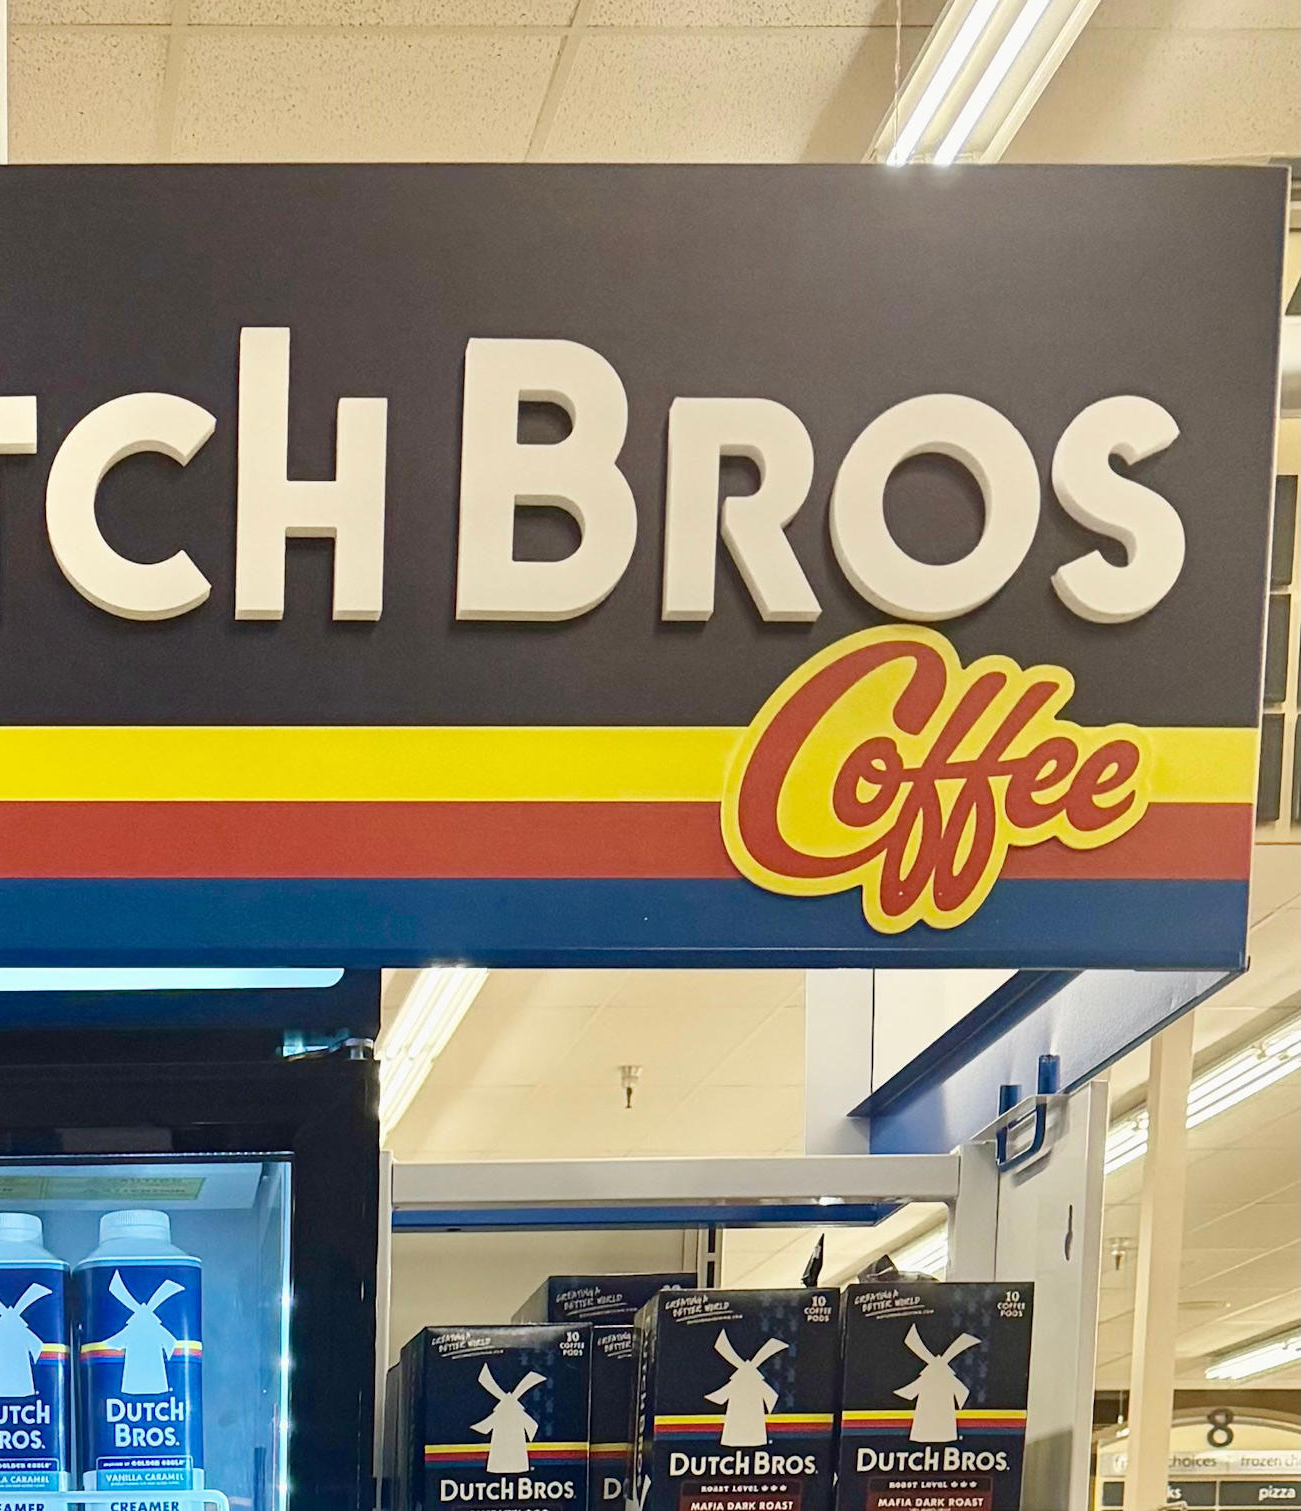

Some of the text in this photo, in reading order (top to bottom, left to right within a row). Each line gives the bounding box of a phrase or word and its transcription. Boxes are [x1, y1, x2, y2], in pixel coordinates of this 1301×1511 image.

[453, 335, 1189, 626] BROS
[738, 640, 1141, 917] Coffee
[1207, 1408, 1234, 1448] 8
[1240, 1456, 1282, 1467] frozen
[1258, 1485, 1297, 1501] pizza
